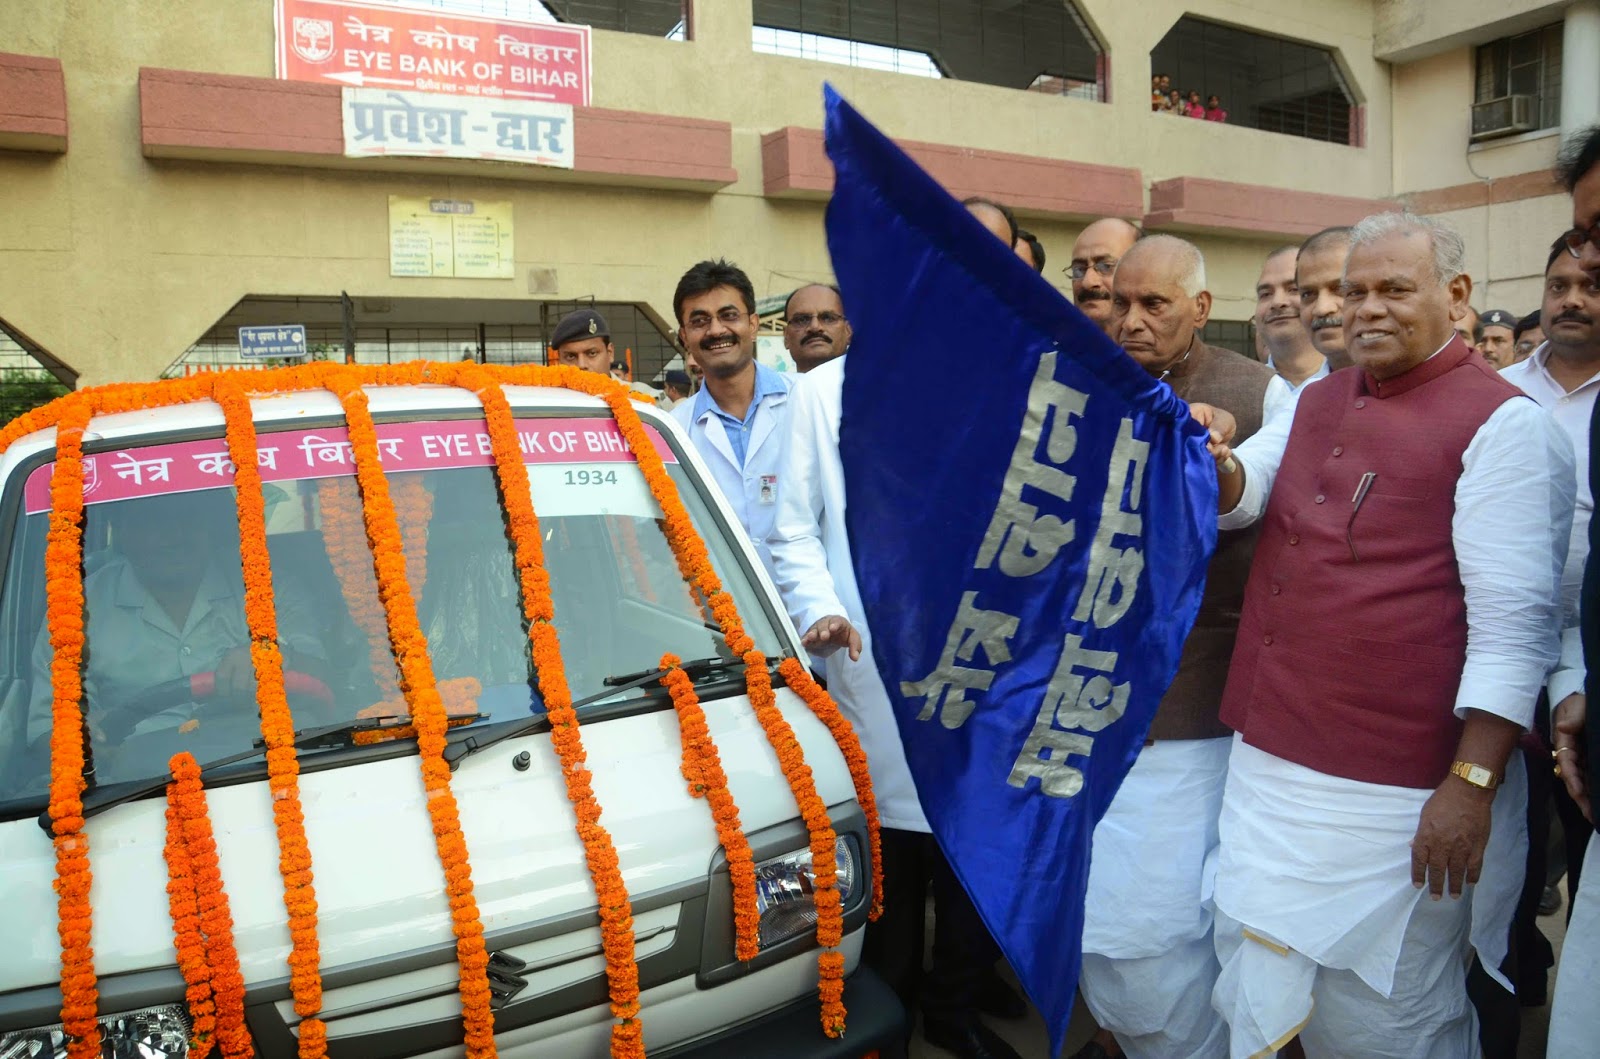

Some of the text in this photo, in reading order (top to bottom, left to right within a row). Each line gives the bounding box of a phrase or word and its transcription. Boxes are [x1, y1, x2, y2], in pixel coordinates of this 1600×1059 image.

[343, 15, 578, 64] नेत्र कोष बिहार
[343, 50, 579, 89] EYE BANK OF BIHAR
[111, 451, 174, 486] नेत्र
[191, 441, 280, 477] कष
[420, 432, 472, 458] EYE
[474, 431, 546, 456] BK
[548, 430, 578, 453] OF
[564, 469, 618, 486] 1934
[900, 350, 1090, 730] नेत्र दान
[1007, 417, 1151, 799] महा दान
